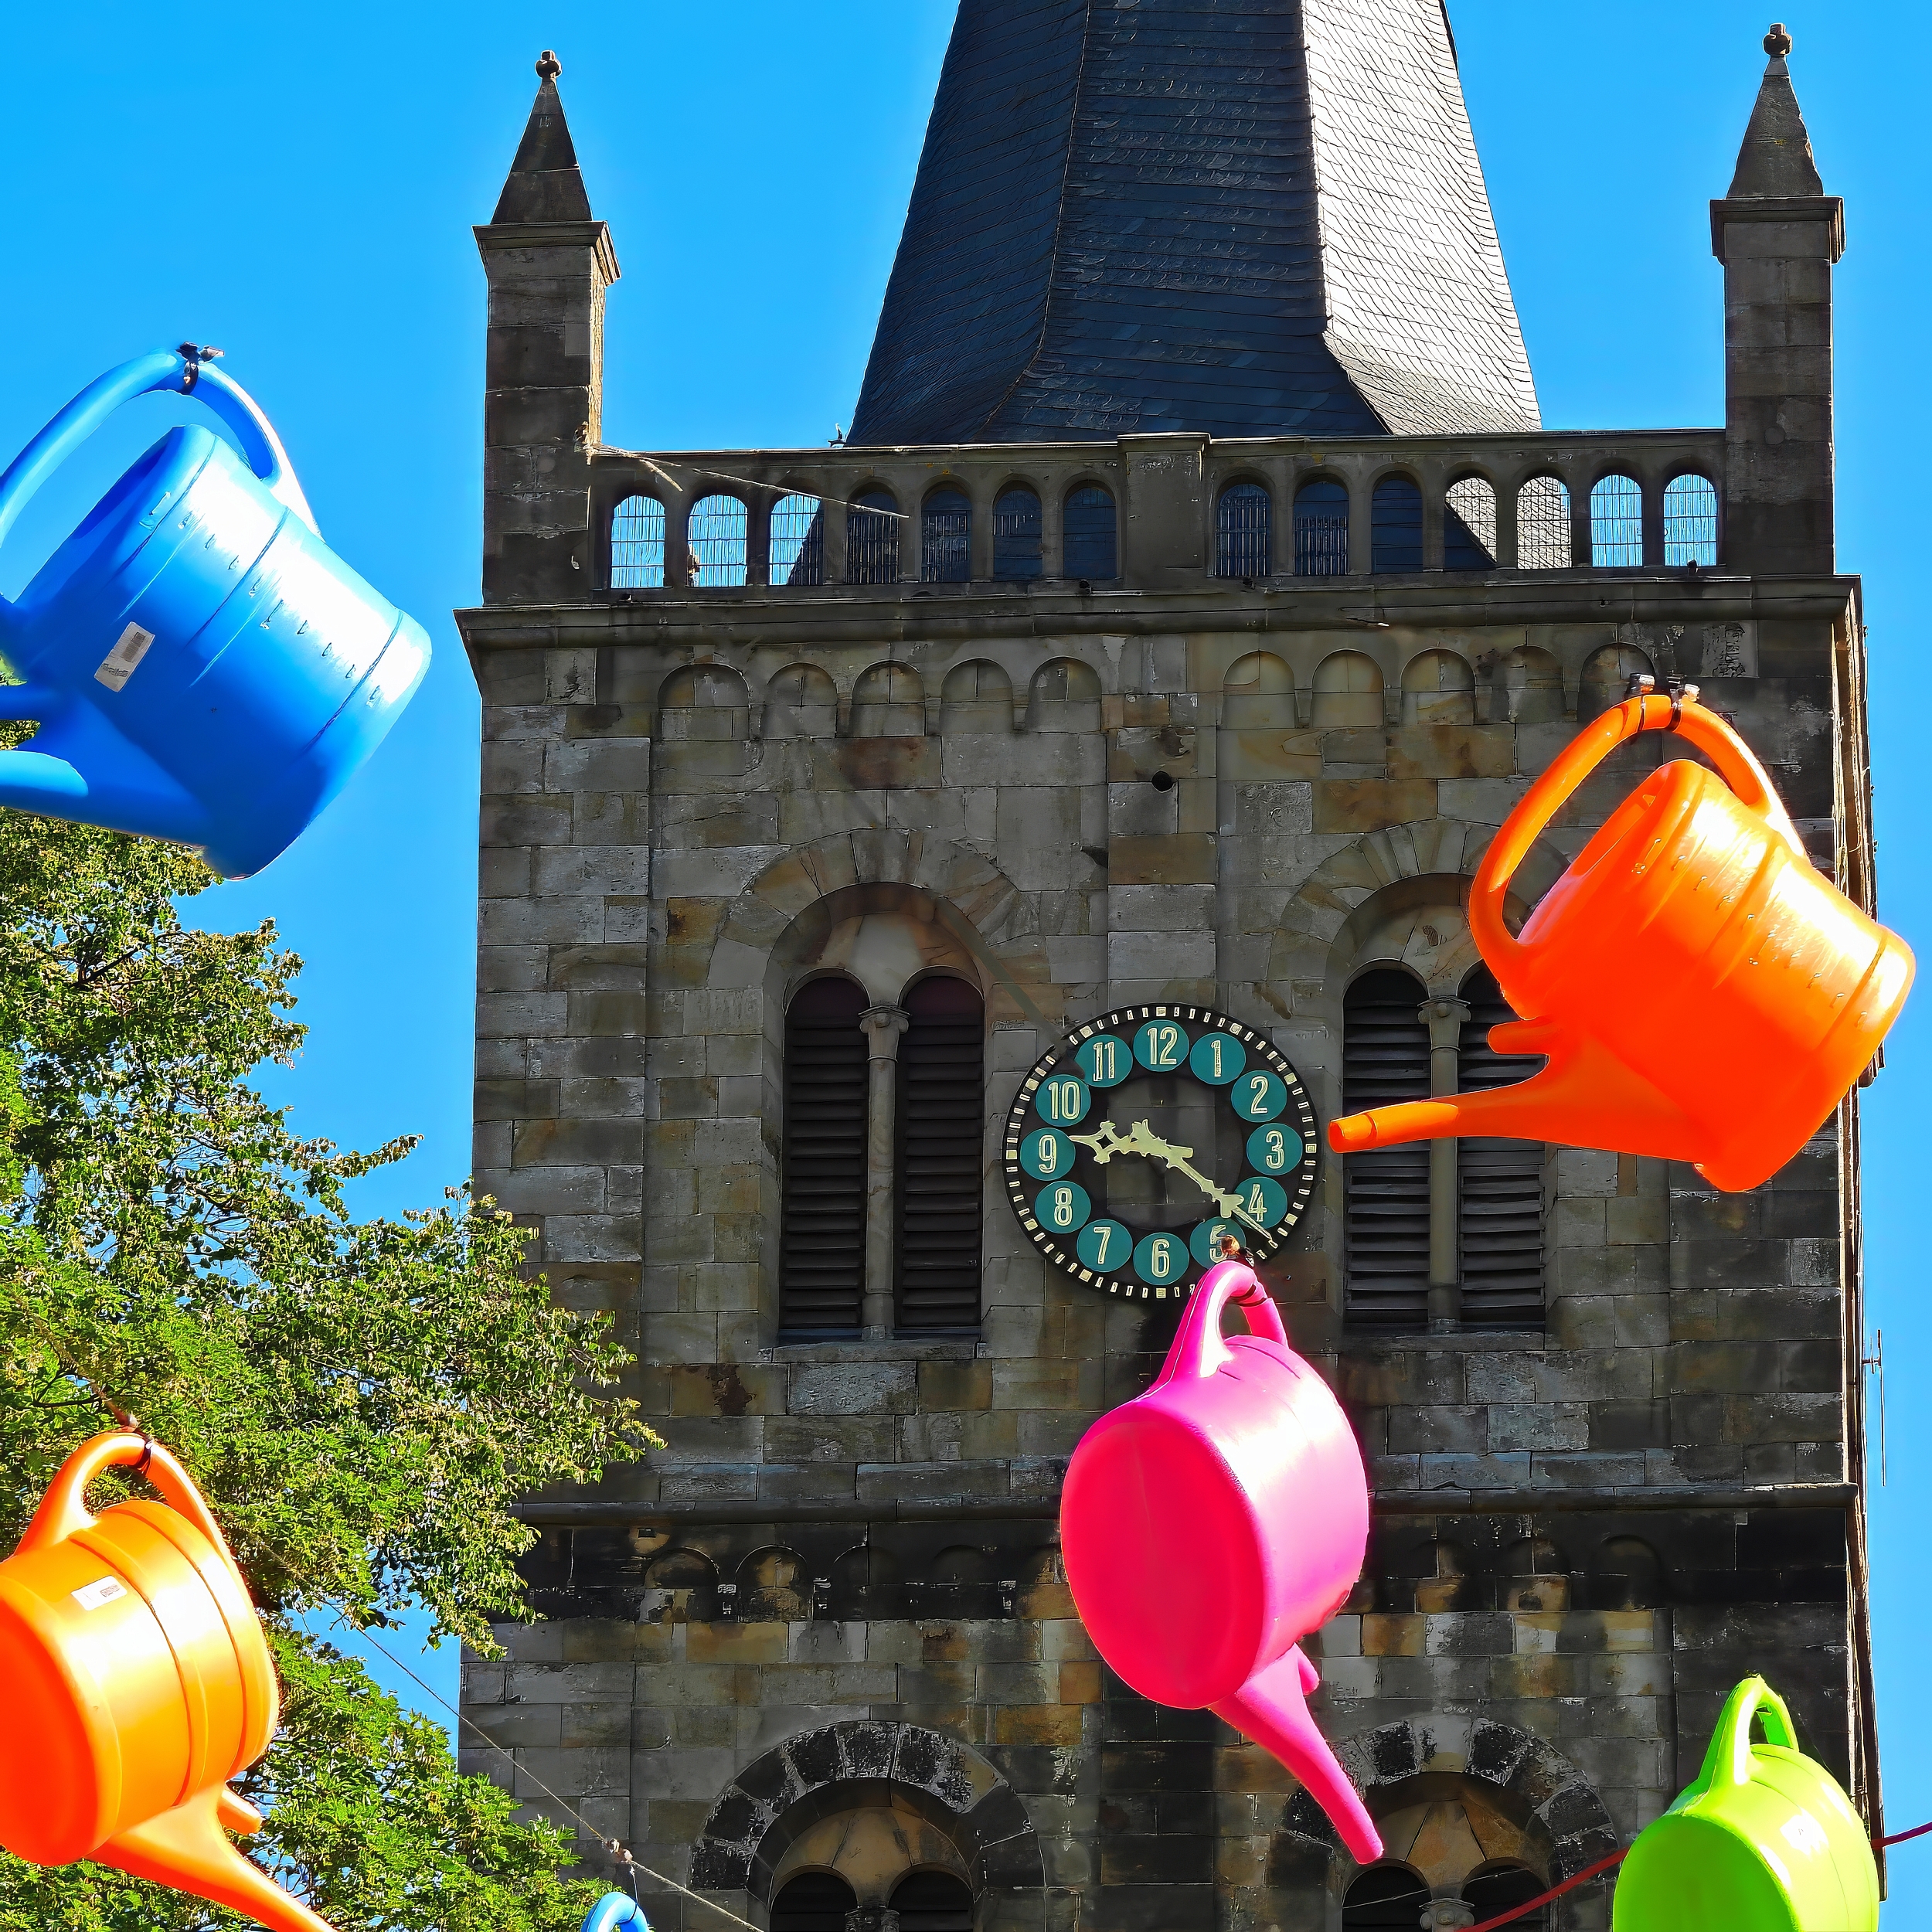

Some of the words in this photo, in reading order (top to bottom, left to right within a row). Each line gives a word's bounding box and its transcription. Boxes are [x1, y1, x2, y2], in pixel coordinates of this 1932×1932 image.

[1094, 1041, 1115, 1081] 11
[1147, 1026, 1177, 1065] 12
[1211, 1040, 1221, 1077] 1
[1048, 1081, 1080, 1120] 10
[1250, 1076, 1268, 1114] 2
[1039, 1134, 1056, 1173] 9
[1266, 1131, 1284, 1168] 3
[1054, 1187, 1073, 1226] 8
[1248, 1184, 1267, 1222] 4
[1094, 1226, 1111, 1264] 7
[1151, 1239, 1169, 1277] 6
